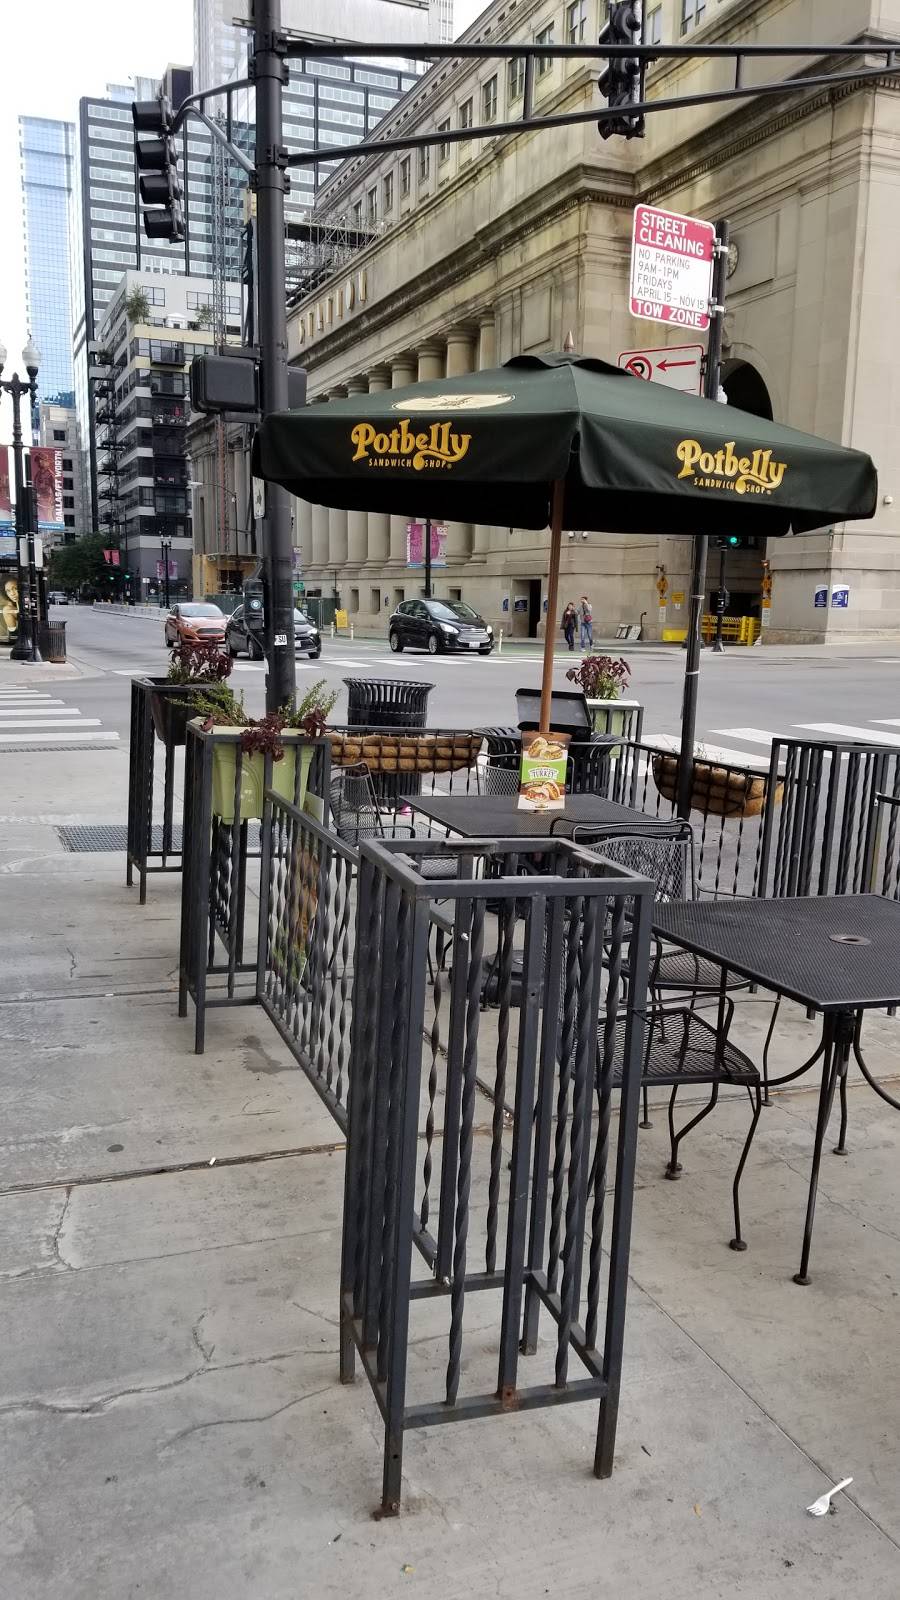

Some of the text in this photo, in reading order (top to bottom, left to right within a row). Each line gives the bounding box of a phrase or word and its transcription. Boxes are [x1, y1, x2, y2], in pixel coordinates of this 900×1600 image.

[641, 213, 688, 236] STREET
[639, 228, 705, 256] CLEANING
[638, 247, 690, 270] NO PARKING
[637, 273, 673, 291] FRIDAYS
[637, 288, 662, 301] APRIL
[664, 291, 672, 302] 15
[679, 295, 696, 308] NOV
[697, 298, 705, 310] 15
[636, 300, 703, 327] TOW ZONE
[351, 418, 472, 471] Potbelly
[368, 457, 412, 468] SANDWICH
[676, 439, 788, 495] Potbelly
[54, 450, 63, 522] DALLAS/FT WORTH
[693, 476, 736, 490] SANDWICH
